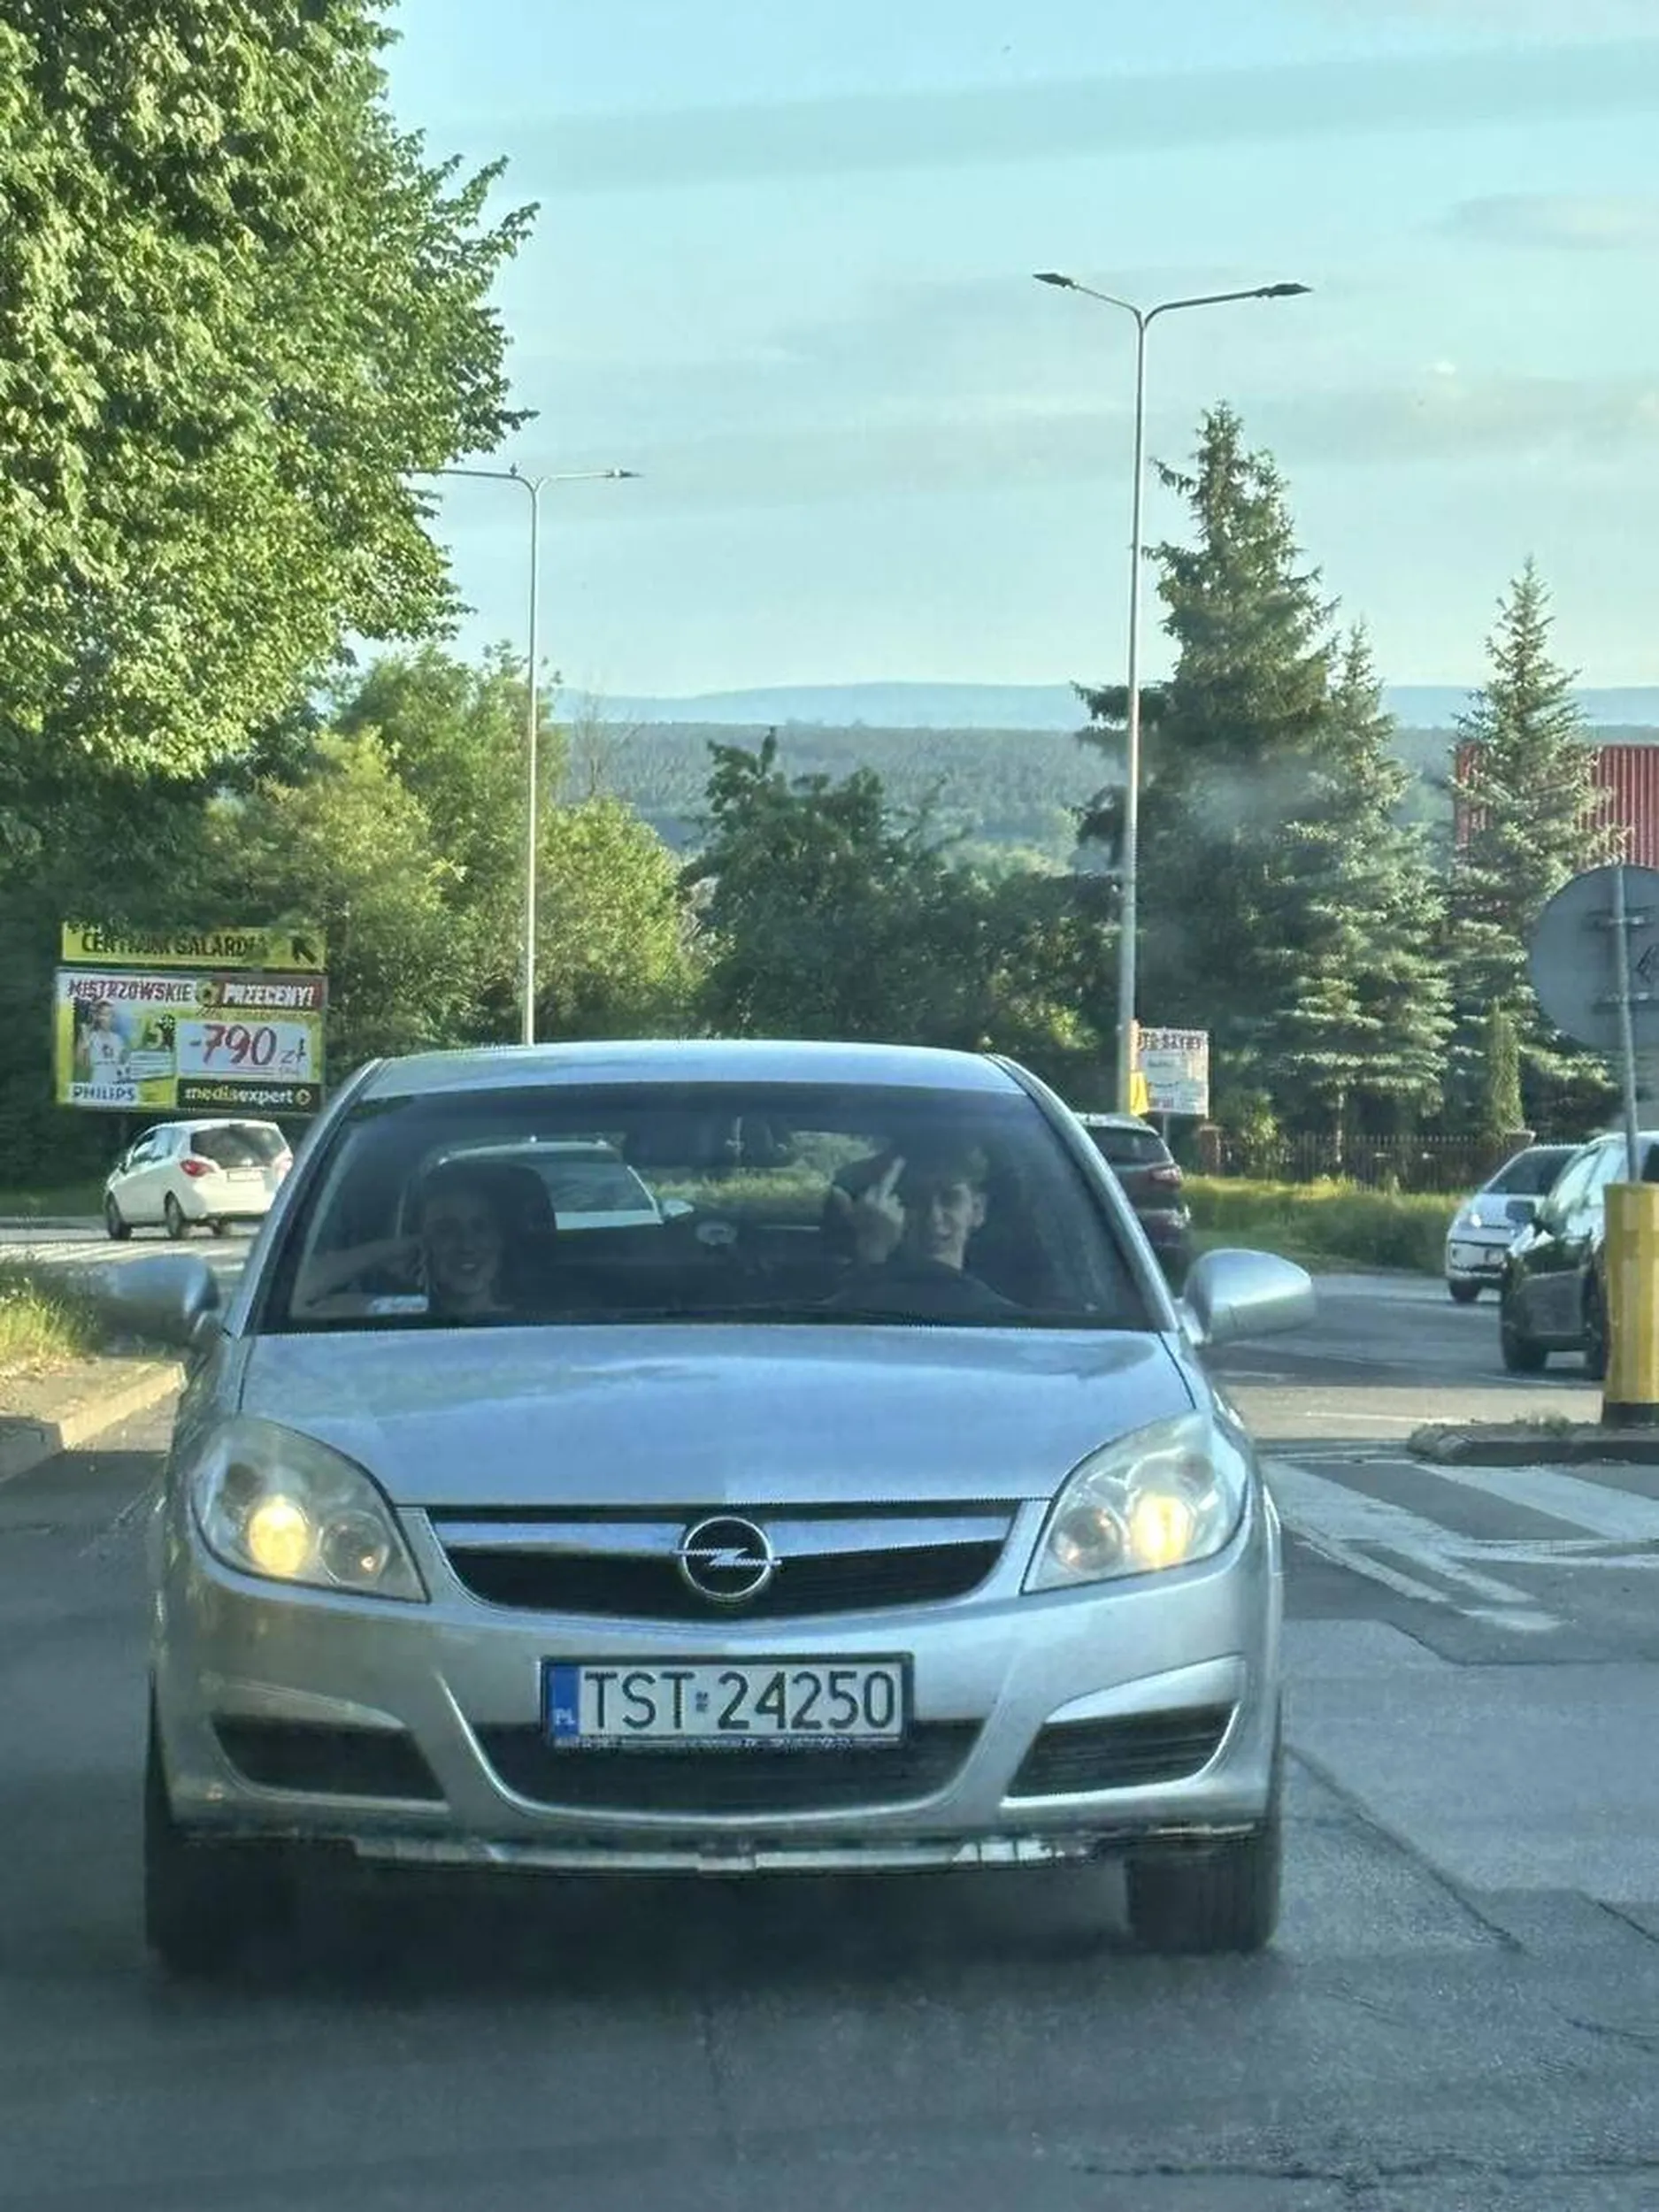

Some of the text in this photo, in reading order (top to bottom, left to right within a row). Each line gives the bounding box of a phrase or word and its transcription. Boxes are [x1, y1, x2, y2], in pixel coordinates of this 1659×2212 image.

[68, 979, 314, 1003] MISTRZOWSKIE PRZECENY!
[280, 1038, 306, 1064] zł
[73, 1085, 134, 1101] PHILIPS
[184, 1086, 293, 1104] mediaexpert
[553, 1671, 895, 1731] PL TST 24250
